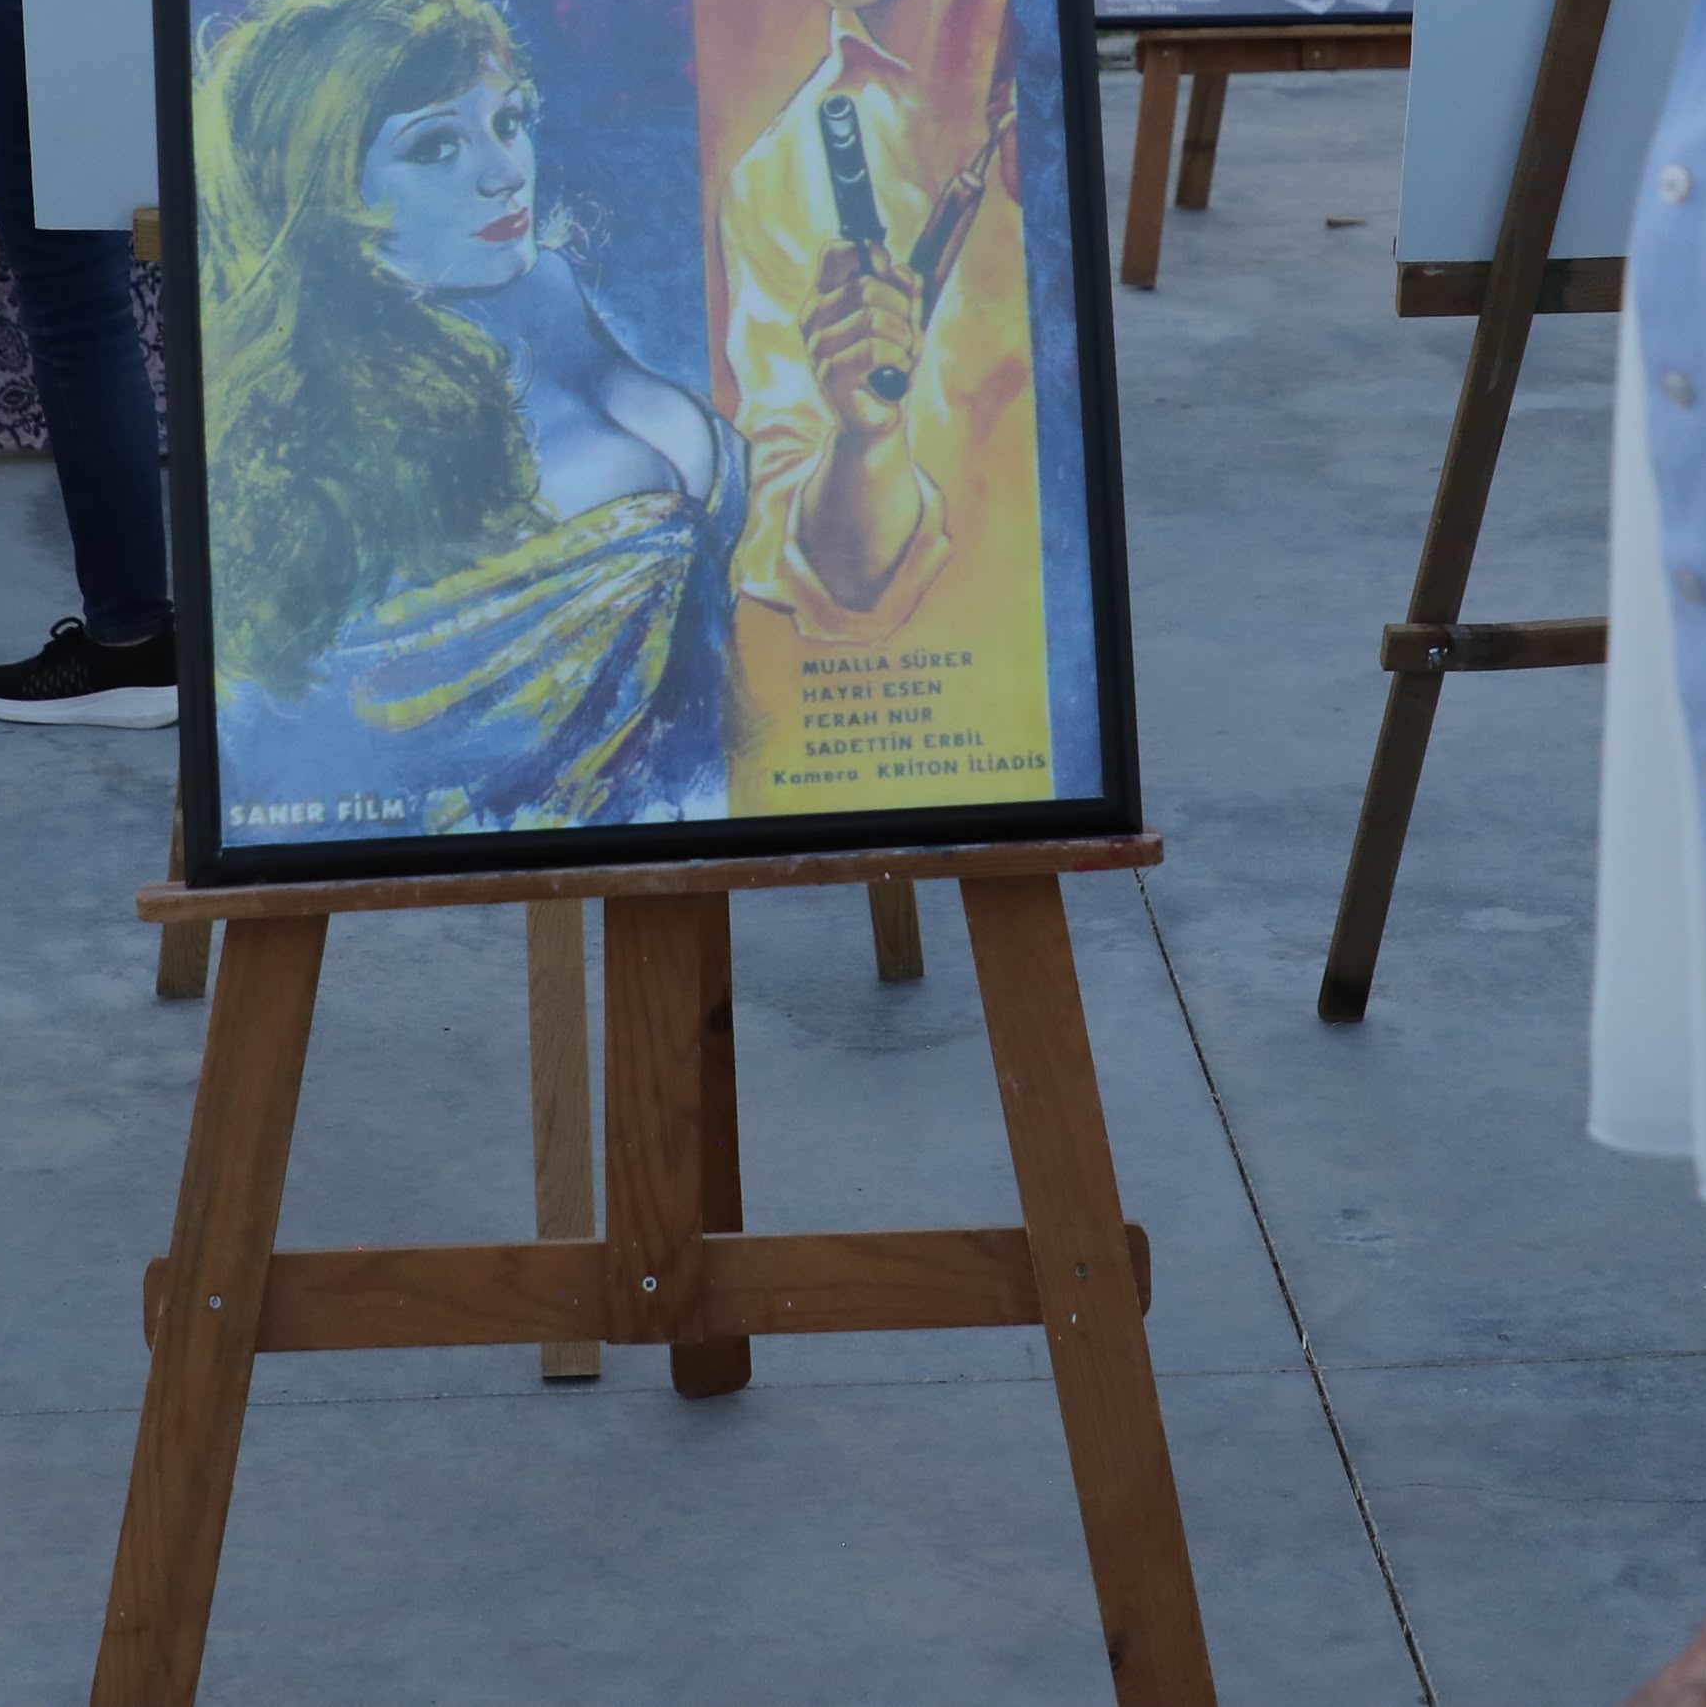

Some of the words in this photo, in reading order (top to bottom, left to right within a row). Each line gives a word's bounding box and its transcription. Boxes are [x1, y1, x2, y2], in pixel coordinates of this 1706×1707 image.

[802, 654, 891, 676] MUALLA
[900, 648, 974, 669] SÜRER
[883, 679, 942, 699] ESEN
[804, 709, 878, 729] FERAH
[888, 706, 934, 725] NUR
[805, 732, 913, 757] SADETTİN
[924, 726, 985, 747] ERBİL
[773, 768, 859, 787] Kamera
[877, 756, 959, 779] KRİTON
[337, 792, 406, 822] FİLM
